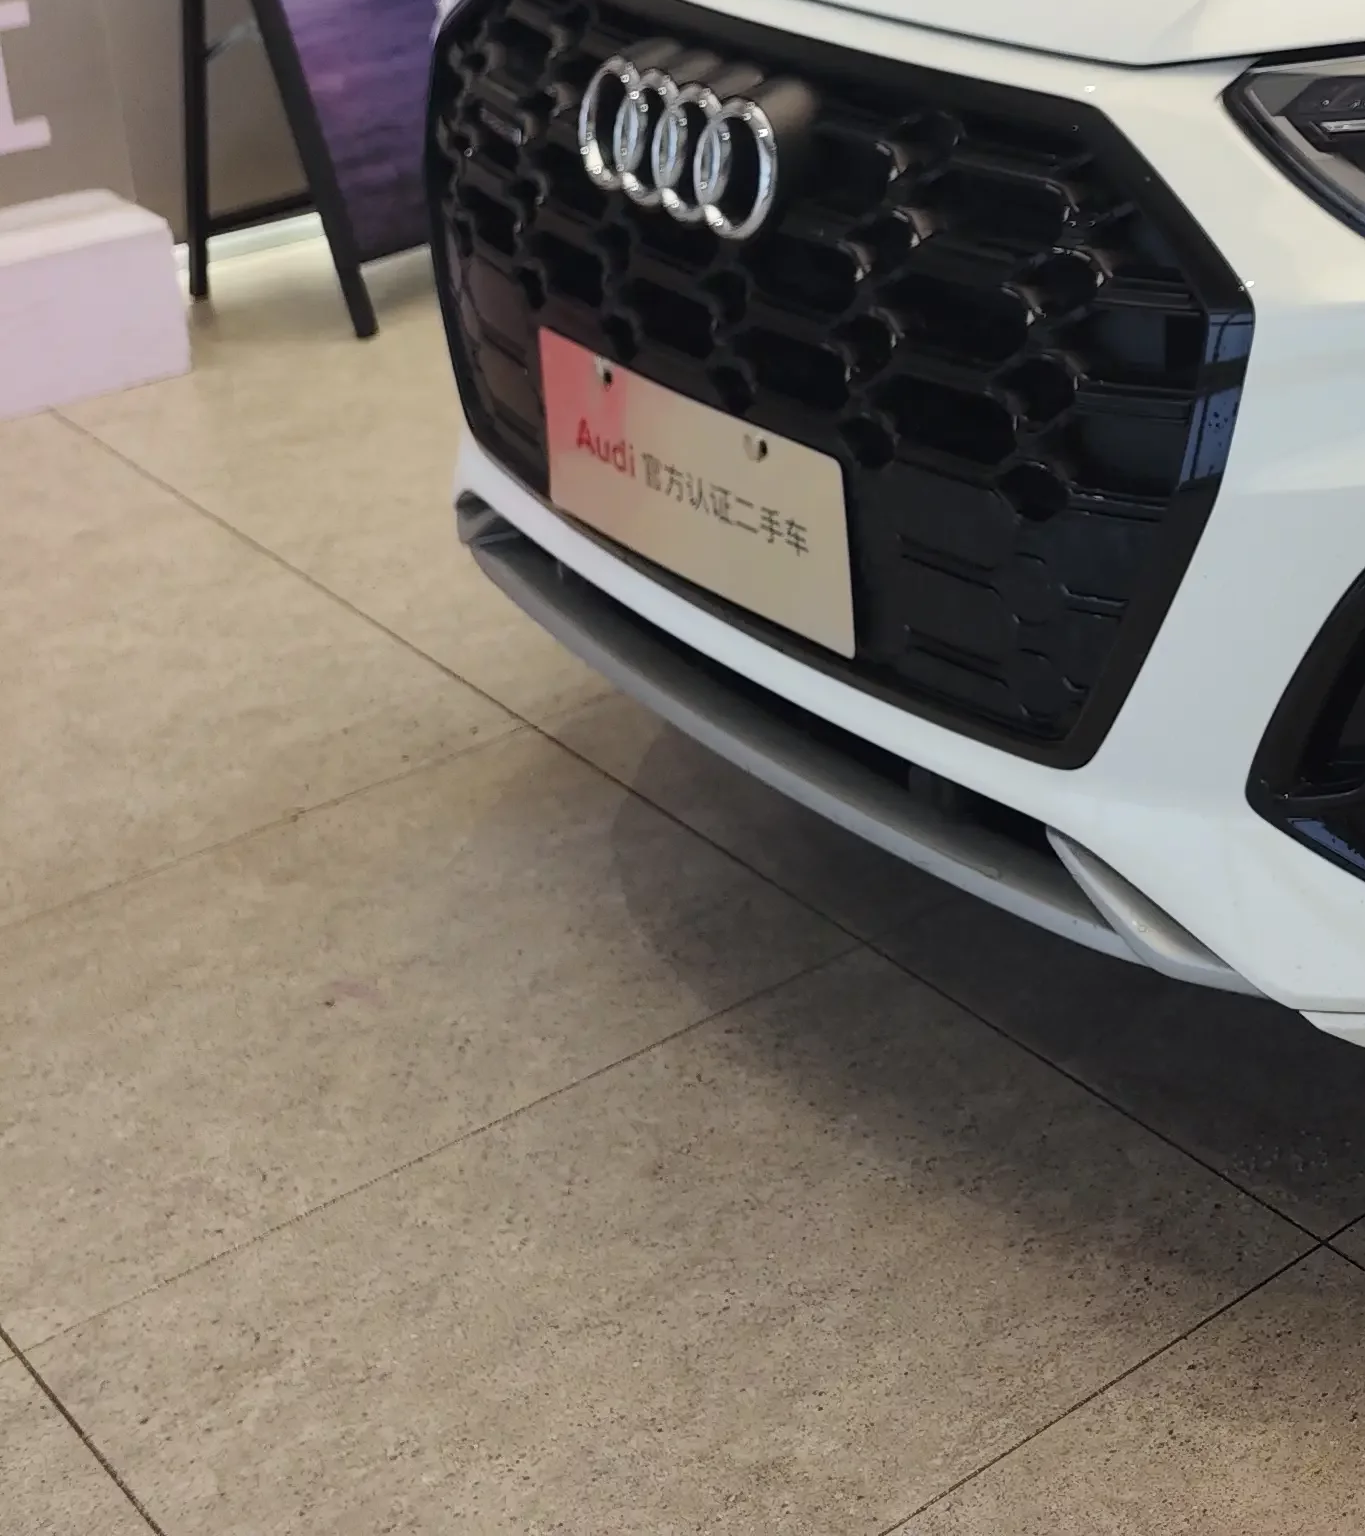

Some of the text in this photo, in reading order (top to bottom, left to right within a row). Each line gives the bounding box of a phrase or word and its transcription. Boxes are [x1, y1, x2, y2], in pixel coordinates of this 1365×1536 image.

[576, 418, 810, 557] Audi 官方认证二手车
